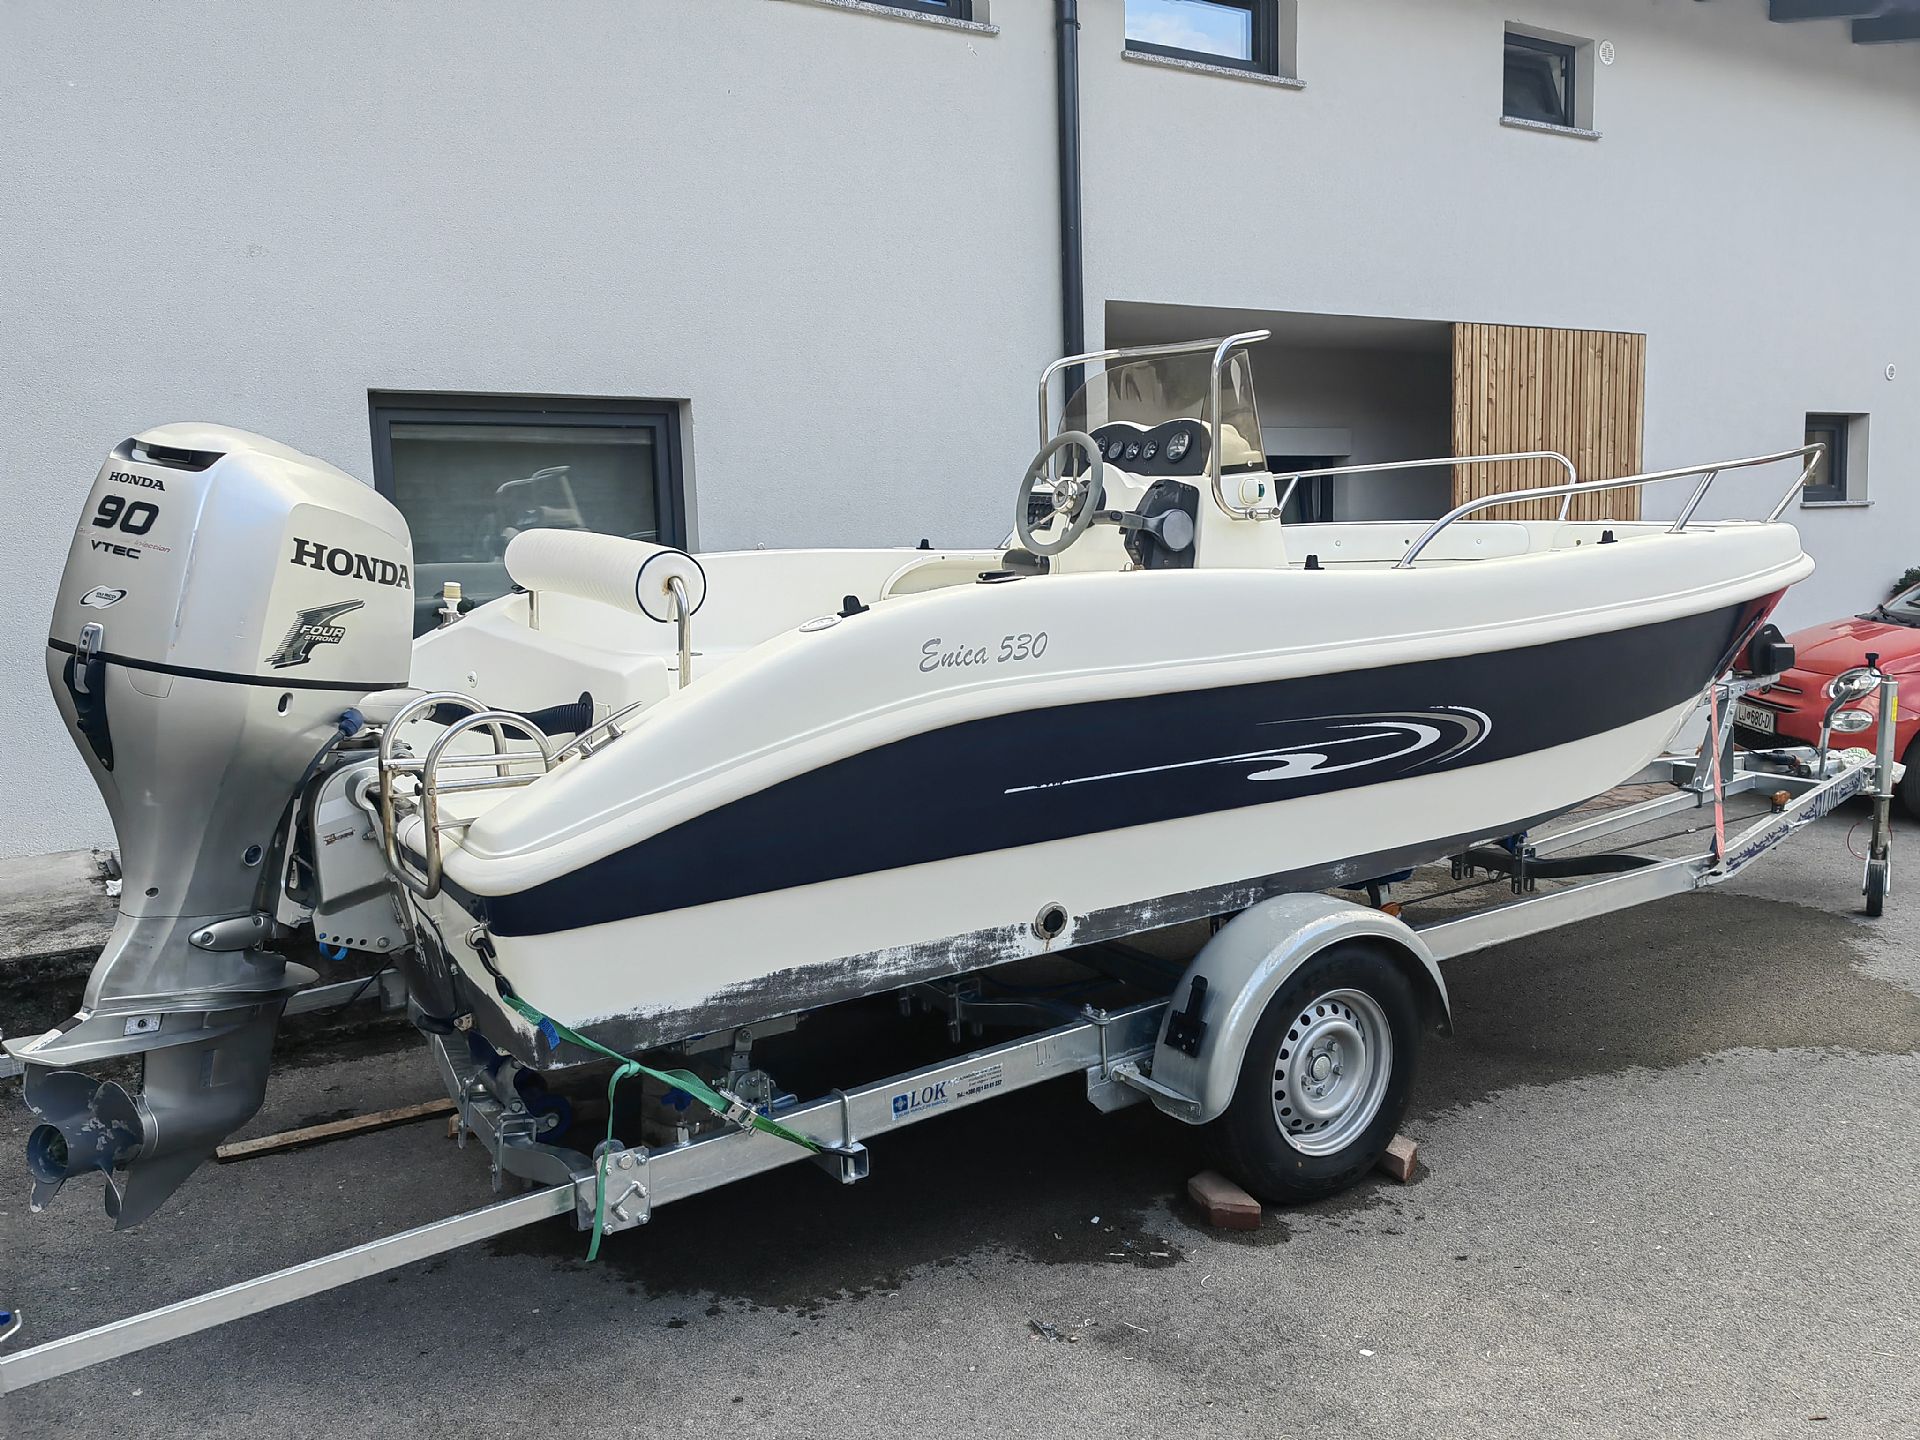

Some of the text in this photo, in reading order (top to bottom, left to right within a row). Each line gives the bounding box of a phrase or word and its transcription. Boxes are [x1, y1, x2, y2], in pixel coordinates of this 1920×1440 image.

[108, 471, 166, 492] HONDA
[92, 494, 160, 536] 90
[91, 539, 141, 559] VTEC
[290, 537, 411, 590] HONDA
[300, 624, 345, 638] FOUR
[304, 634, 340, 643] STROKE
[919, 631, 1048, 673] Enica 530
[910, 1081, 947, 1108] LOK
